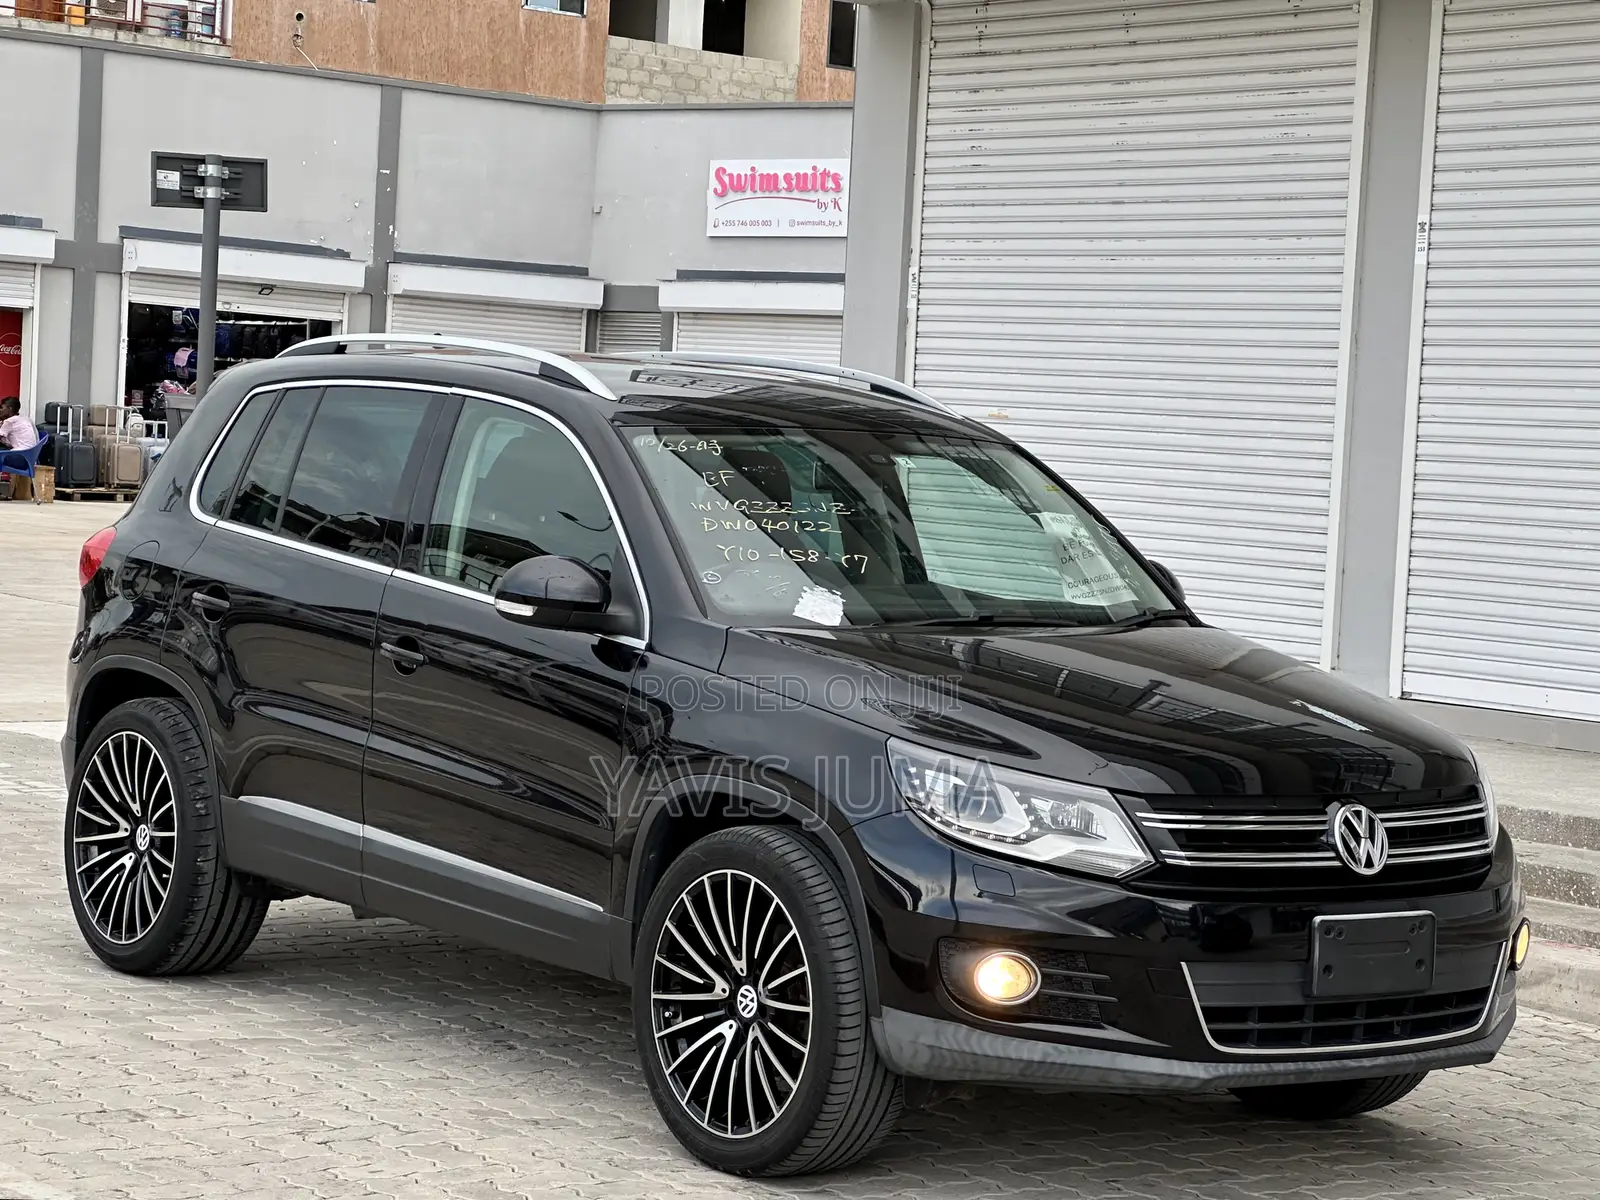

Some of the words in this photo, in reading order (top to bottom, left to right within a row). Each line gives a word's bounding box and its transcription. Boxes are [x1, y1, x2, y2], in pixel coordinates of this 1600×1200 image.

[713, 165, 843, 198] Swimsuits
[816, 198, 829, 212] by
[831, 197, 843, 212] K
[721, 219, 736, 227] +255
[737, 219, 748, 227] 746
[749, 219, 761, 227] 005
[761, 219, 772, 227] 003
[796, 219, 843, 229] swimsuits_by_k
